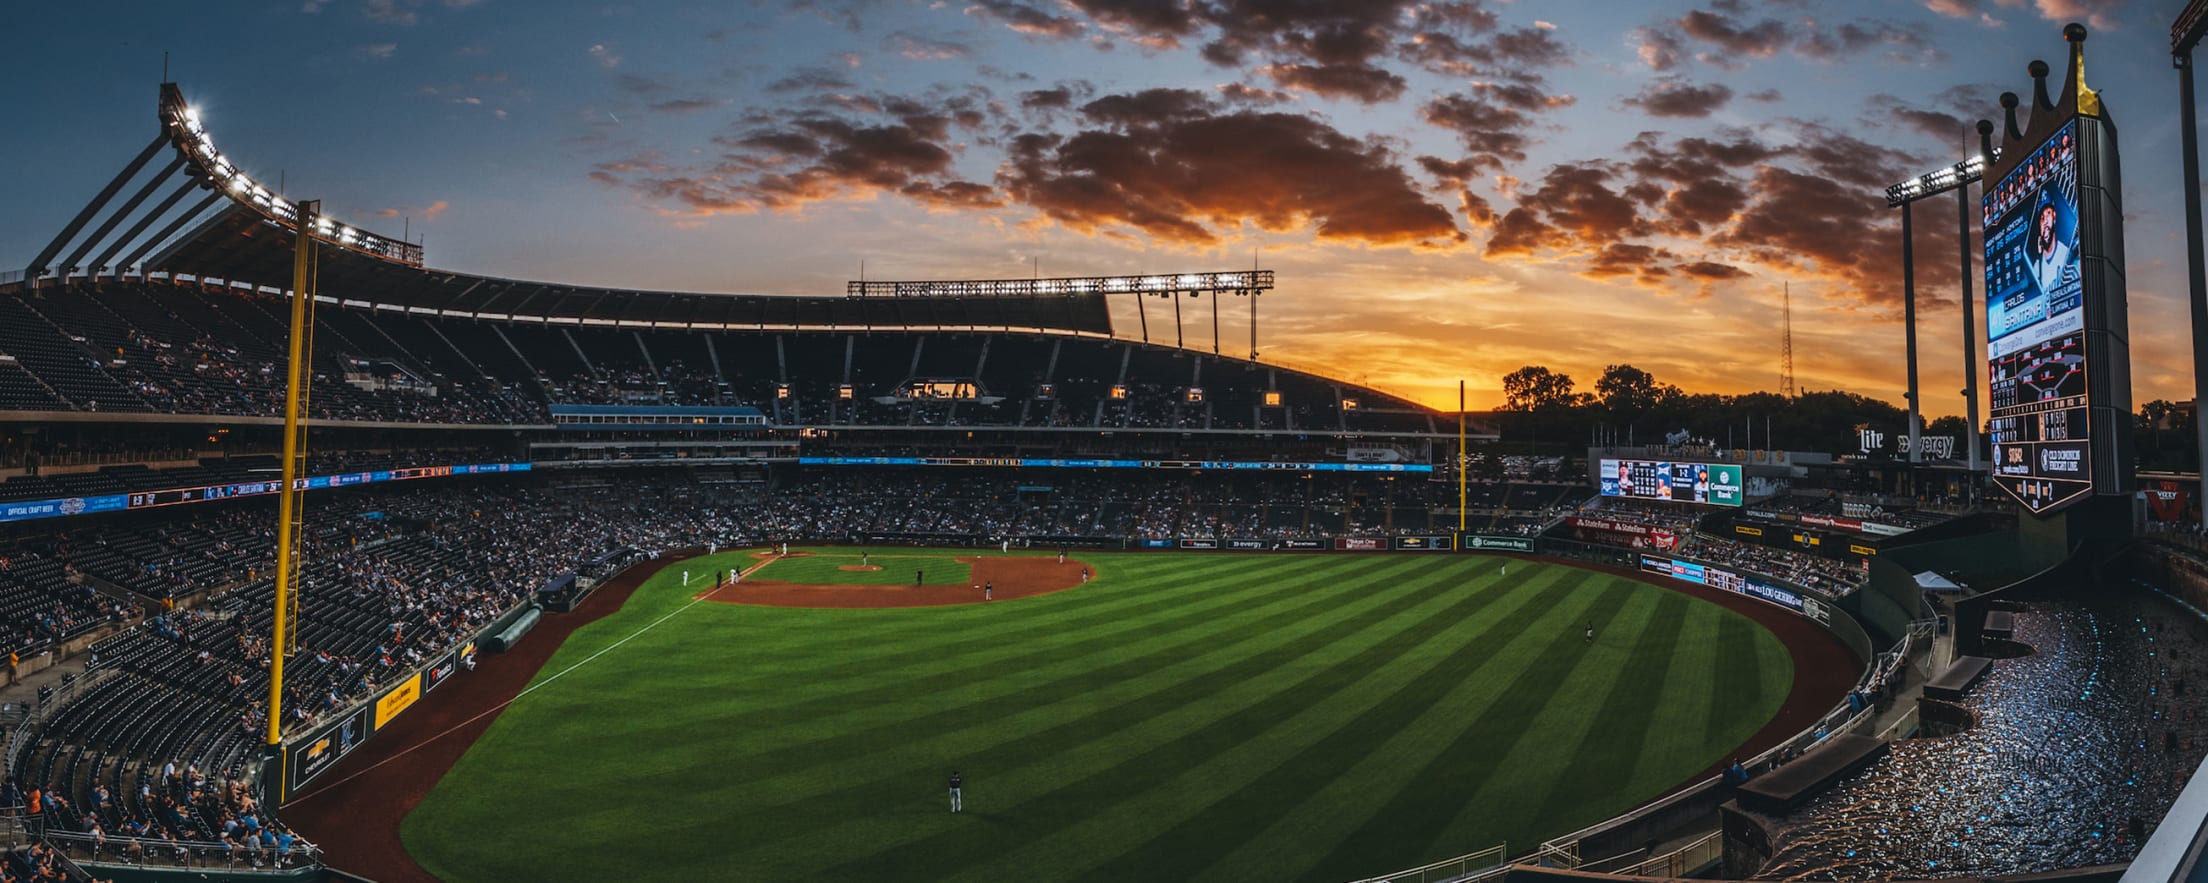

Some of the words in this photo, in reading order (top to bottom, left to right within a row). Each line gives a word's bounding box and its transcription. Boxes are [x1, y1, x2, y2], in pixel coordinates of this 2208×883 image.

[2004, 292, 2025, 311] CARLOS
[2004, 301, 2044, 330] SANTANA
[1860, 428, 1884, 454] Lite
[2048, 450, 2057, 460] OLD
[2057, 450, 2080, 461] DOMINION
[2049, 461, 2067, 471] FREIGHT
[2067, 461, 2079, 471] LINE
[1710, 482, 1740, 493] Commerce
[2048, 482, 2053, 501] 2
[1717, 490, 1732, 499] Bank
[7, 507, 28, 516] OFFICIAL
[28, 505, 42, 514] CRAFT
[1239, 541, 1262, 550] evergy
[1482, 539, 1513, 547] Commerce
[1762, 586, 1774, 597] LOU
[1774, 590, 1795, 605] GEHRIG
[304, 751, 331, 775] CHEVROLET
